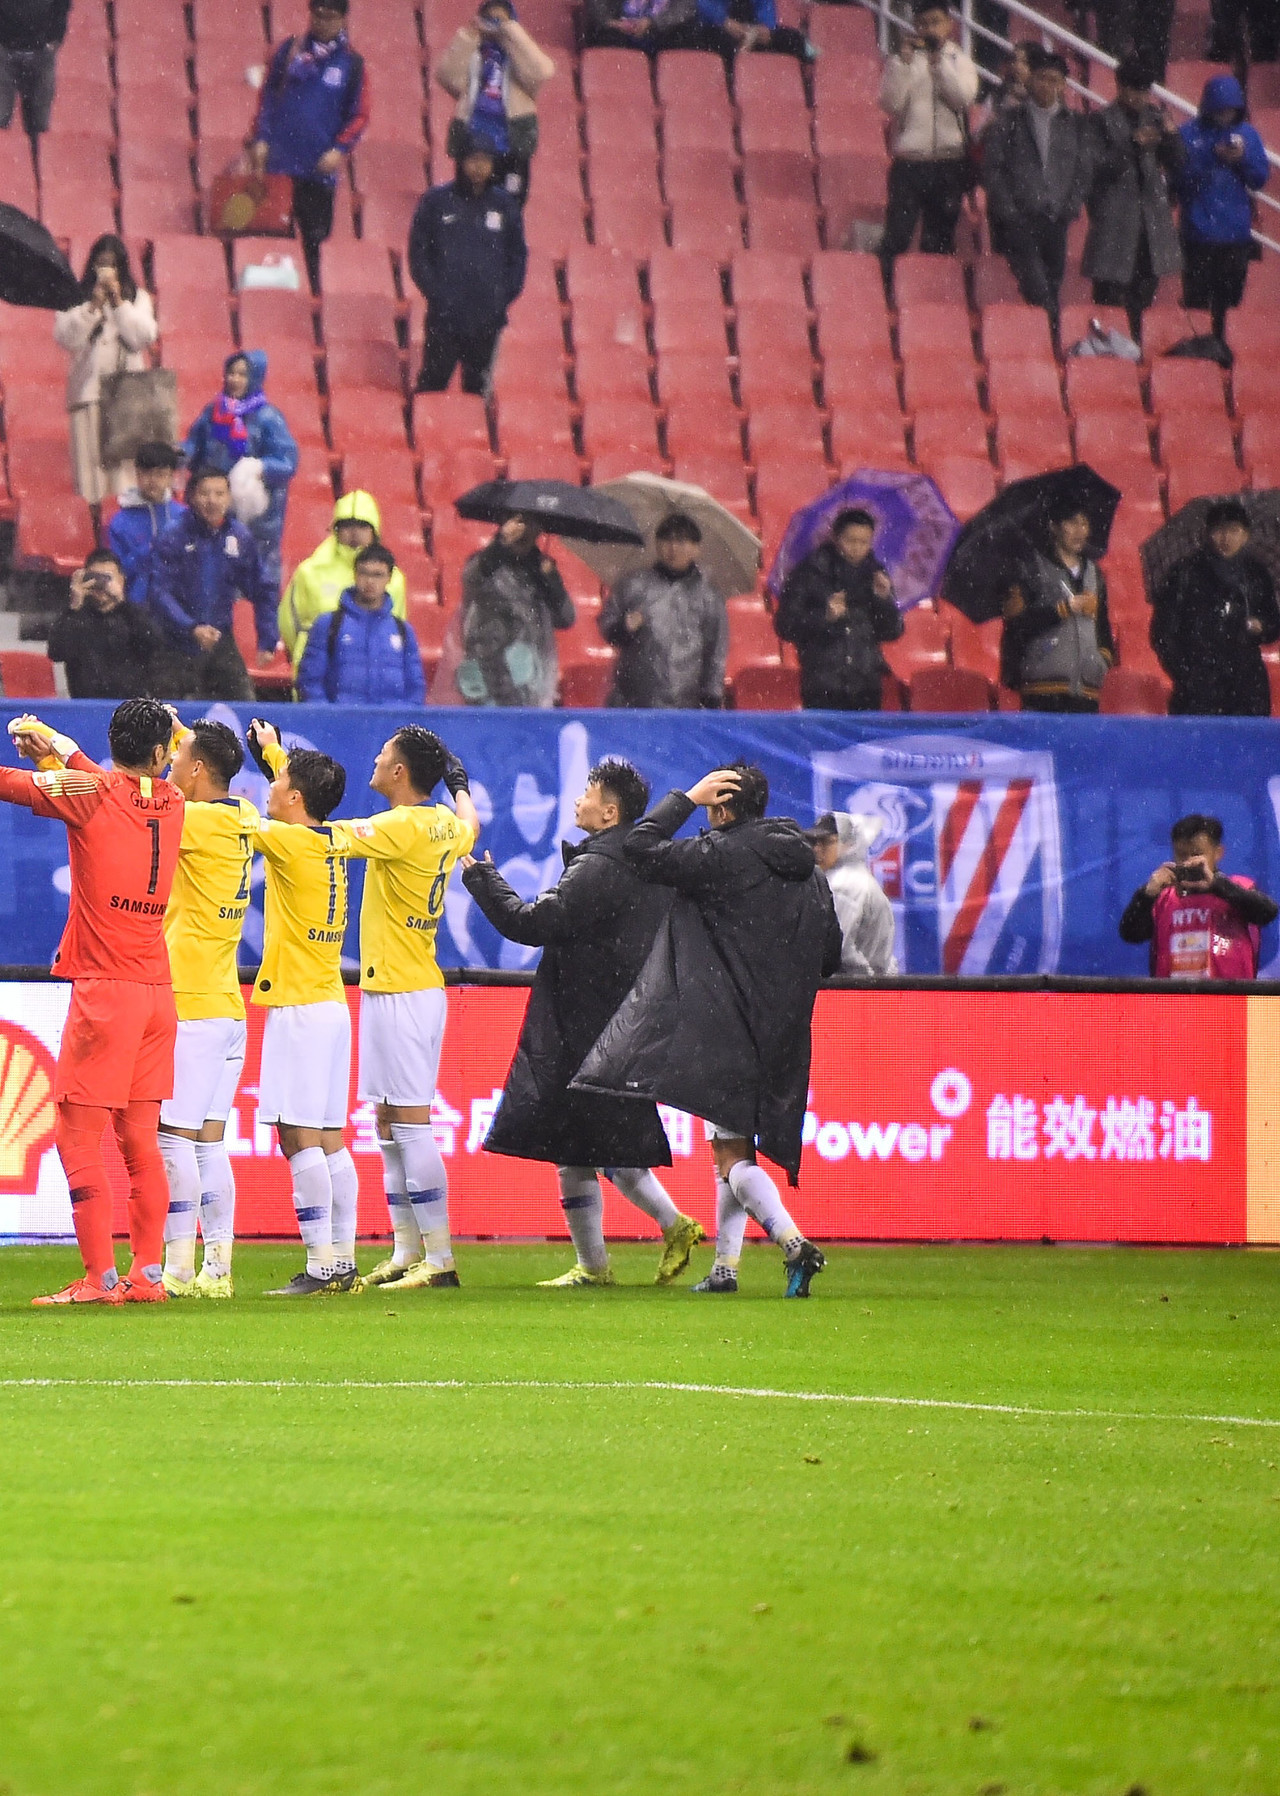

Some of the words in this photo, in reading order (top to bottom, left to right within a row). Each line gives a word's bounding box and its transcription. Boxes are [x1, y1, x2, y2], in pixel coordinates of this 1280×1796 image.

[146, 819, 160, 896] 1
[428, 849, 451, 916] 6
[986, 1093, 1213, 1162] 能效燃油
